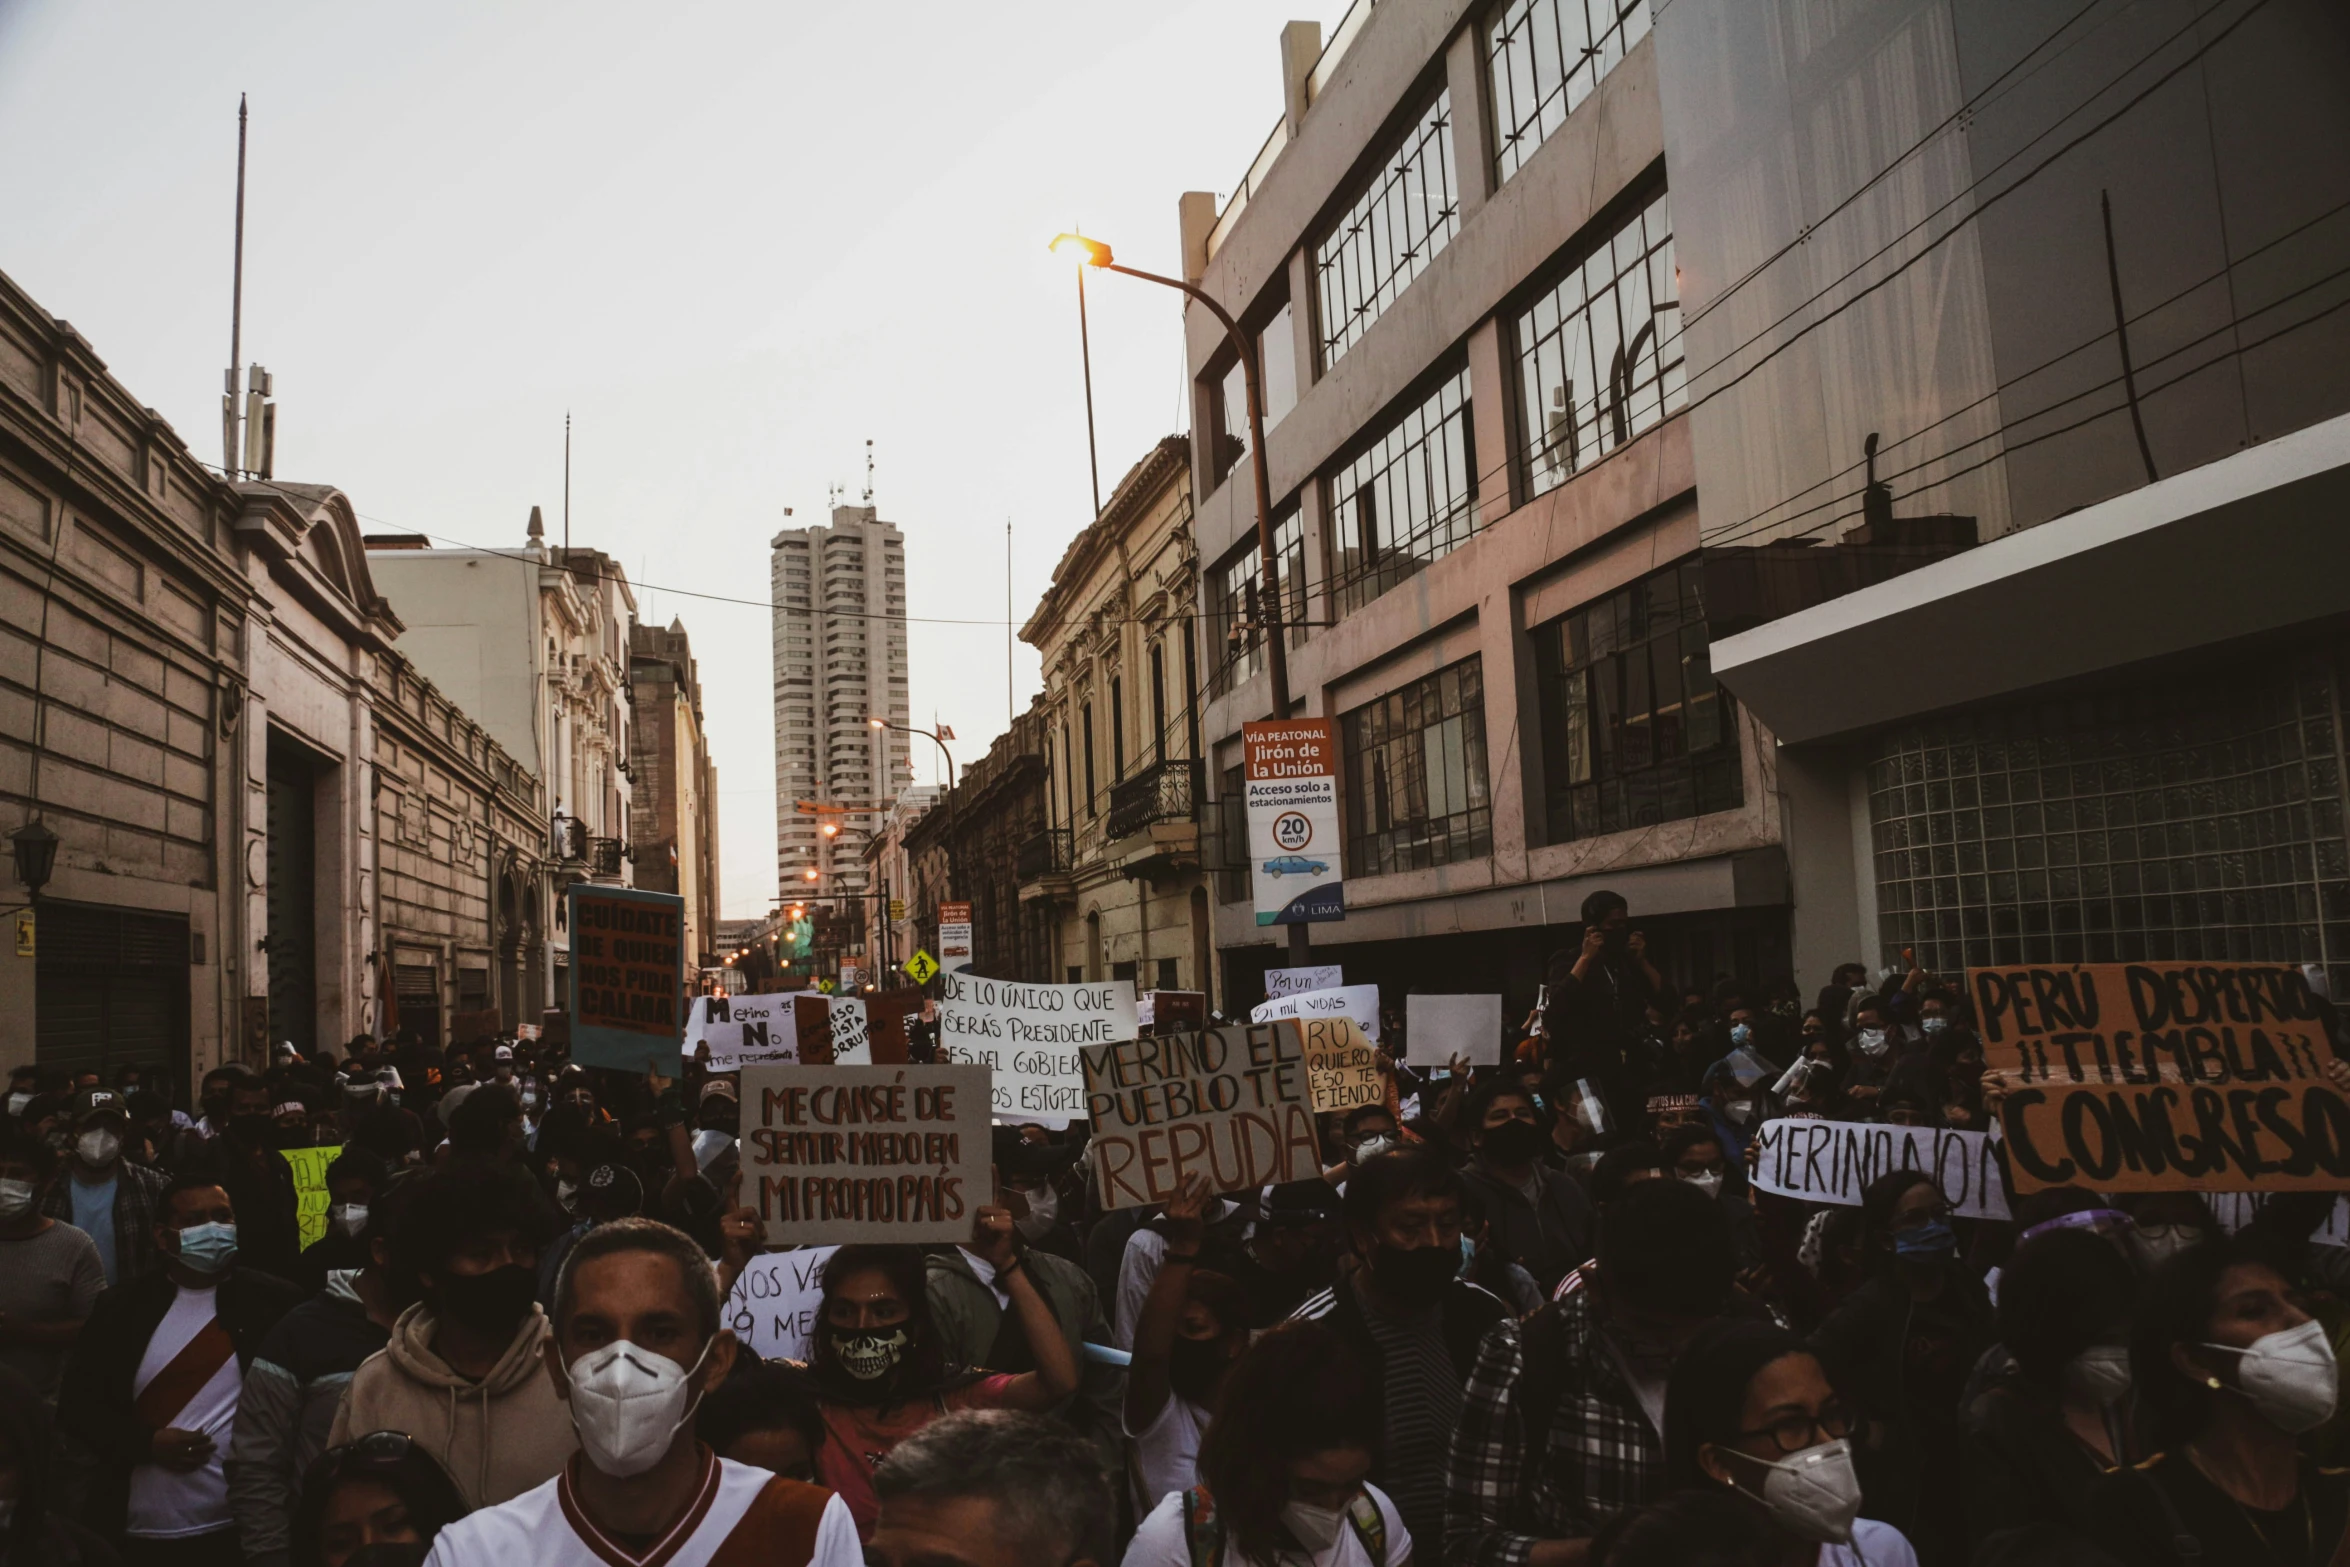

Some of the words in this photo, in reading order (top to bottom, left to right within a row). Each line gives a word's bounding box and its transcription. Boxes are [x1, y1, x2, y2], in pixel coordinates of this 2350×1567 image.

[1246, 731, 1266, 743] VÍA
[1268, 729, 1327, 741] PEATONAL
[1254, 744, 1295, 763] Jirón
[1299, 743, 1320, 757] de
[1253, 763, 1269, 778] la
[1273, 760, 1324, 776] Unión
[1249, 785, 1292, 796] Acceso
[1294, 781, 1320, 793] solo
[1323, 783, 1330, 791] a
[1249, 795, 1332, 808] estacionamientos
[1281, 818, 1305, 835] 20
[1282, 835, 1305, 843] km/h
[577, 902, 676, 938] CUÍDATE
[943, 910, 958, 918] Jirón
[1311, 905, 1341, 915] LIMA
[577, 934, 604, 957] DE
[613, 938, 677, 967] QUIEN
[580, 963, 621, 988] NOS
[625, 968, 673, 996] PIDA
[945, 973, 966, 1001] DE
[975, 982, 995, 1006] LO
[1001, 983, 1063, 1011] ÚNICO
[1074, 989, 1114, 1011] QUE
[1295, 977, 1312, 989] un
[581, 987, 674, 1026] CALMA
[706, 997, 770, 1024] Merino
[1306, 997, 1346, 1011] VIDAS
[1976, 964, 2099, 1042] PERÚ
[742, 1022, 782, 1047] No
[944, 1010, 1001, 1037] SERÁS
[1006, 1017, 1116, 1043] PRESIDENTE
[709, 1054, 733, 1066] me
[1078, 1028, 1227, 1091] MERINO
[1245, 1024, 1302, 1067] EL
[1309, 1049, 1370, 1072] QUIERO
[1311, 1072, 1344, 1088] ESO
[1357, 1067, 1375, 1082] TE
[762, 1086, 808, 1127] ME
[810, 1071, 907, 1125] CANSÉ
[915, 1085, 956, 1121] DE
[1087, 1074, 1239, 1133] PUEBLO
[1243, 1063, 1301, 1108] TE
[2001, 1085, 2350, 1182] CONGRESO
[751, 1128, 847, 1165] SENTIR
[848, 1131, 922, 1165] MIEDO
[924, 1132, 960, 1165] EN
[759, 1176, 799, 1222] MI
[802, 1176, 895, 1223] PROPIO
[897, 1165, 965, 1222] PAÍS
